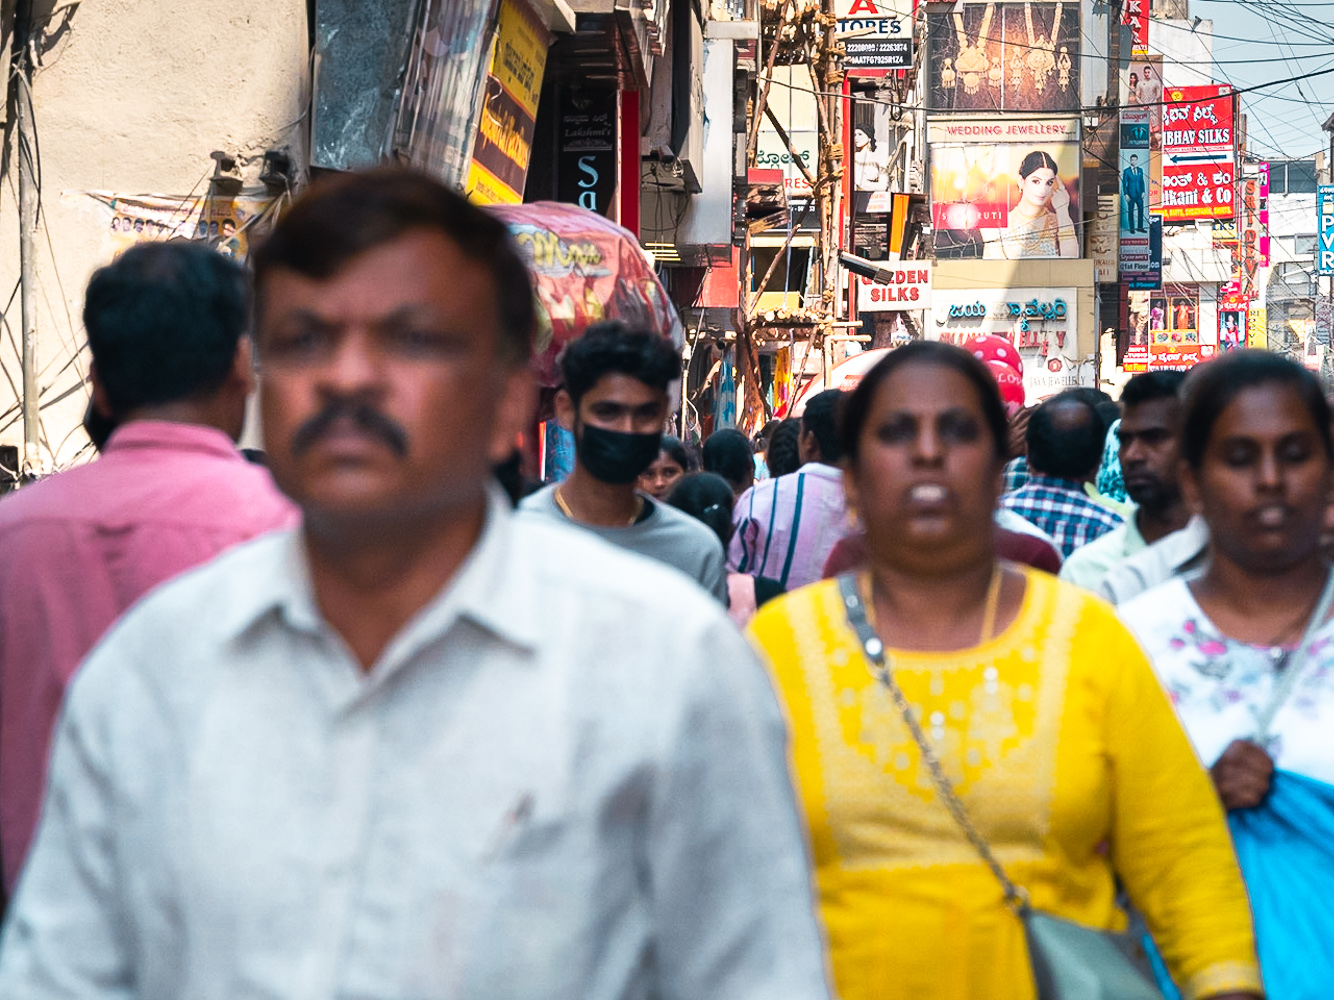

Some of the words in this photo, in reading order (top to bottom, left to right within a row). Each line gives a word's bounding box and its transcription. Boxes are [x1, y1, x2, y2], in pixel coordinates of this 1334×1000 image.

[834, 20, 901, 34] TORES
[947, 125, 1001, 135] WEDDING
[1006, 124, 1067, 135] JEWELLERY
[1198, 128, 1230, 144] SILKS
[1202, 188, 1213, 203] &
[1216, 187, 1231, 203] Co
[870, 287, 920, 302] SILKS
